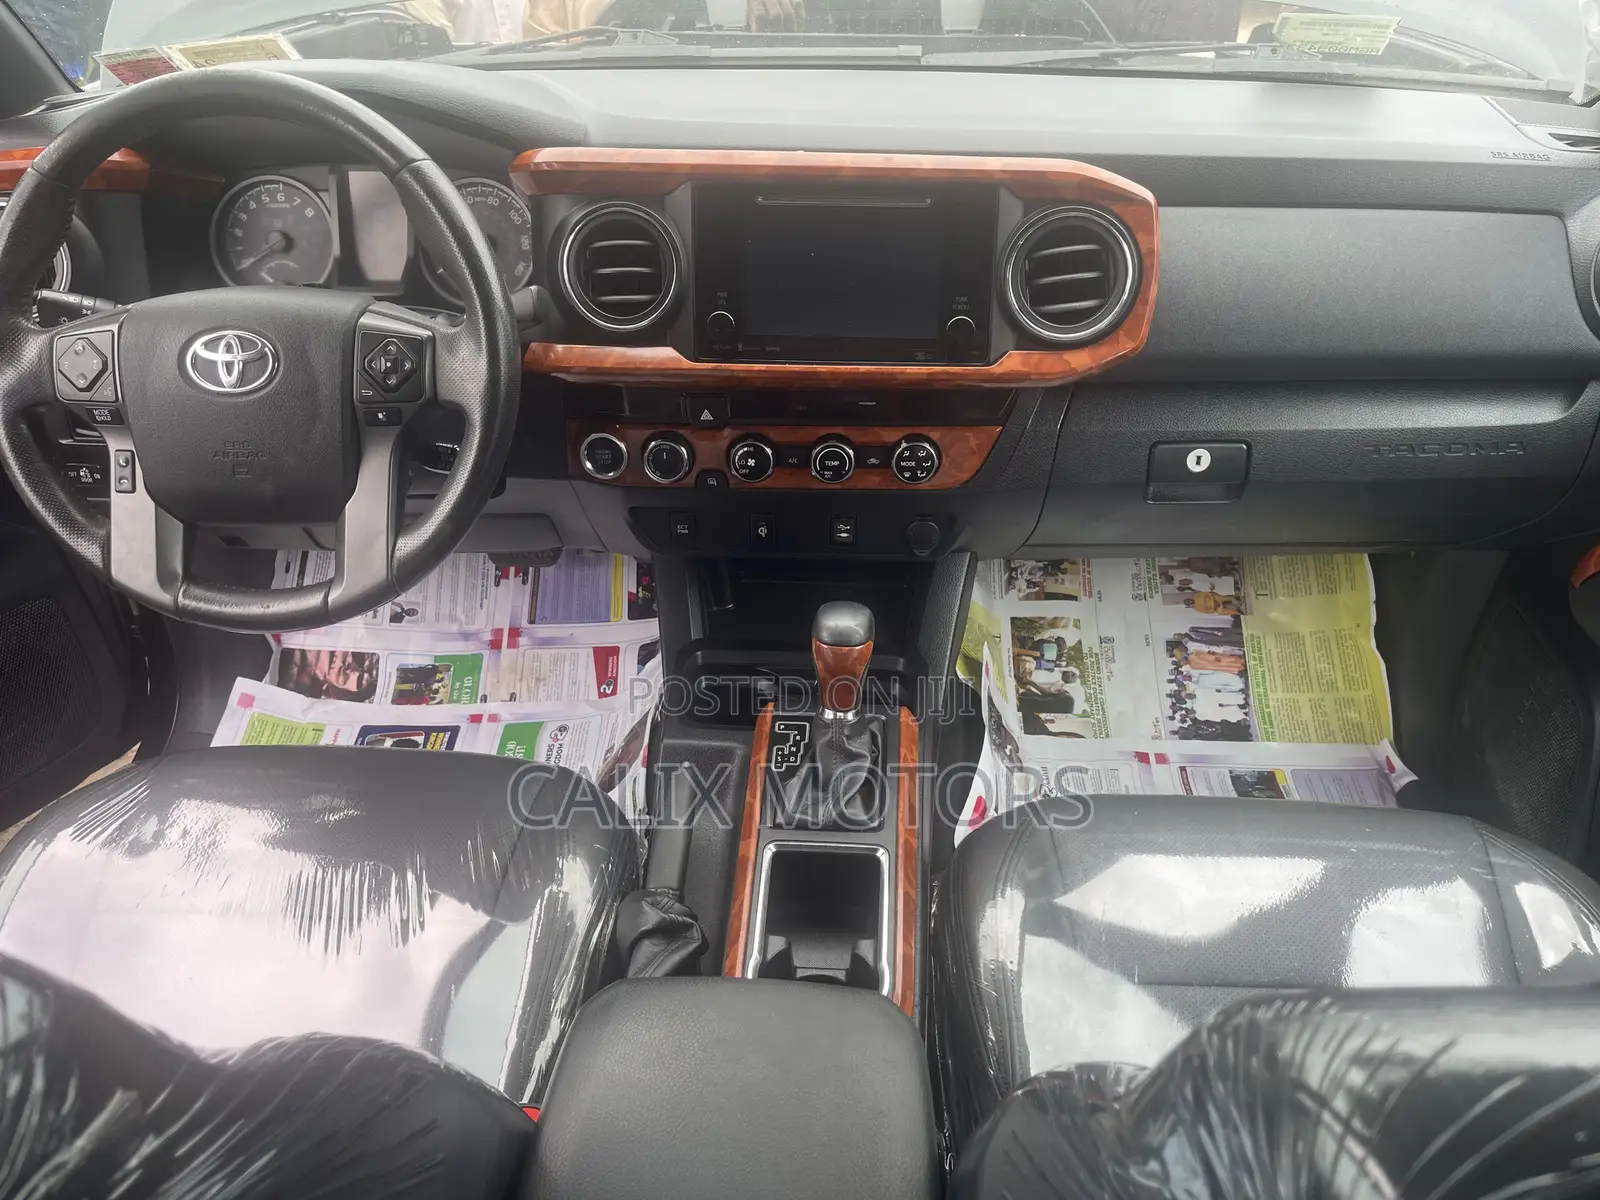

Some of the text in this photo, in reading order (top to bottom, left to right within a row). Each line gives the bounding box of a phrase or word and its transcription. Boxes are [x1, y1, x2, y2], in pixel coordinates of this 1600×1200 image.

[262, 194, 270, 203] 5
[277, 192, 285, 202] 6
[292, 197, 301, 206] 7
[487, 196, 500, 206] 80
[249, 200, 256, 210] 4
[238, 212, 247, 222] 3
[304, 208, 314, 218] 8
[508, 209, 522, 225] 100
[234, 228, 242, 237] 2
[521, 235, 530, 250] 120
[1364, 442, 1526, 457] TACOMA
[1089, 660, 1097, 685] JUSTICE
[1092, 687, 1100, 716] DONATES
[545, 743, 555, 764] NERS
[554, 743, 565, 766] GDOM
